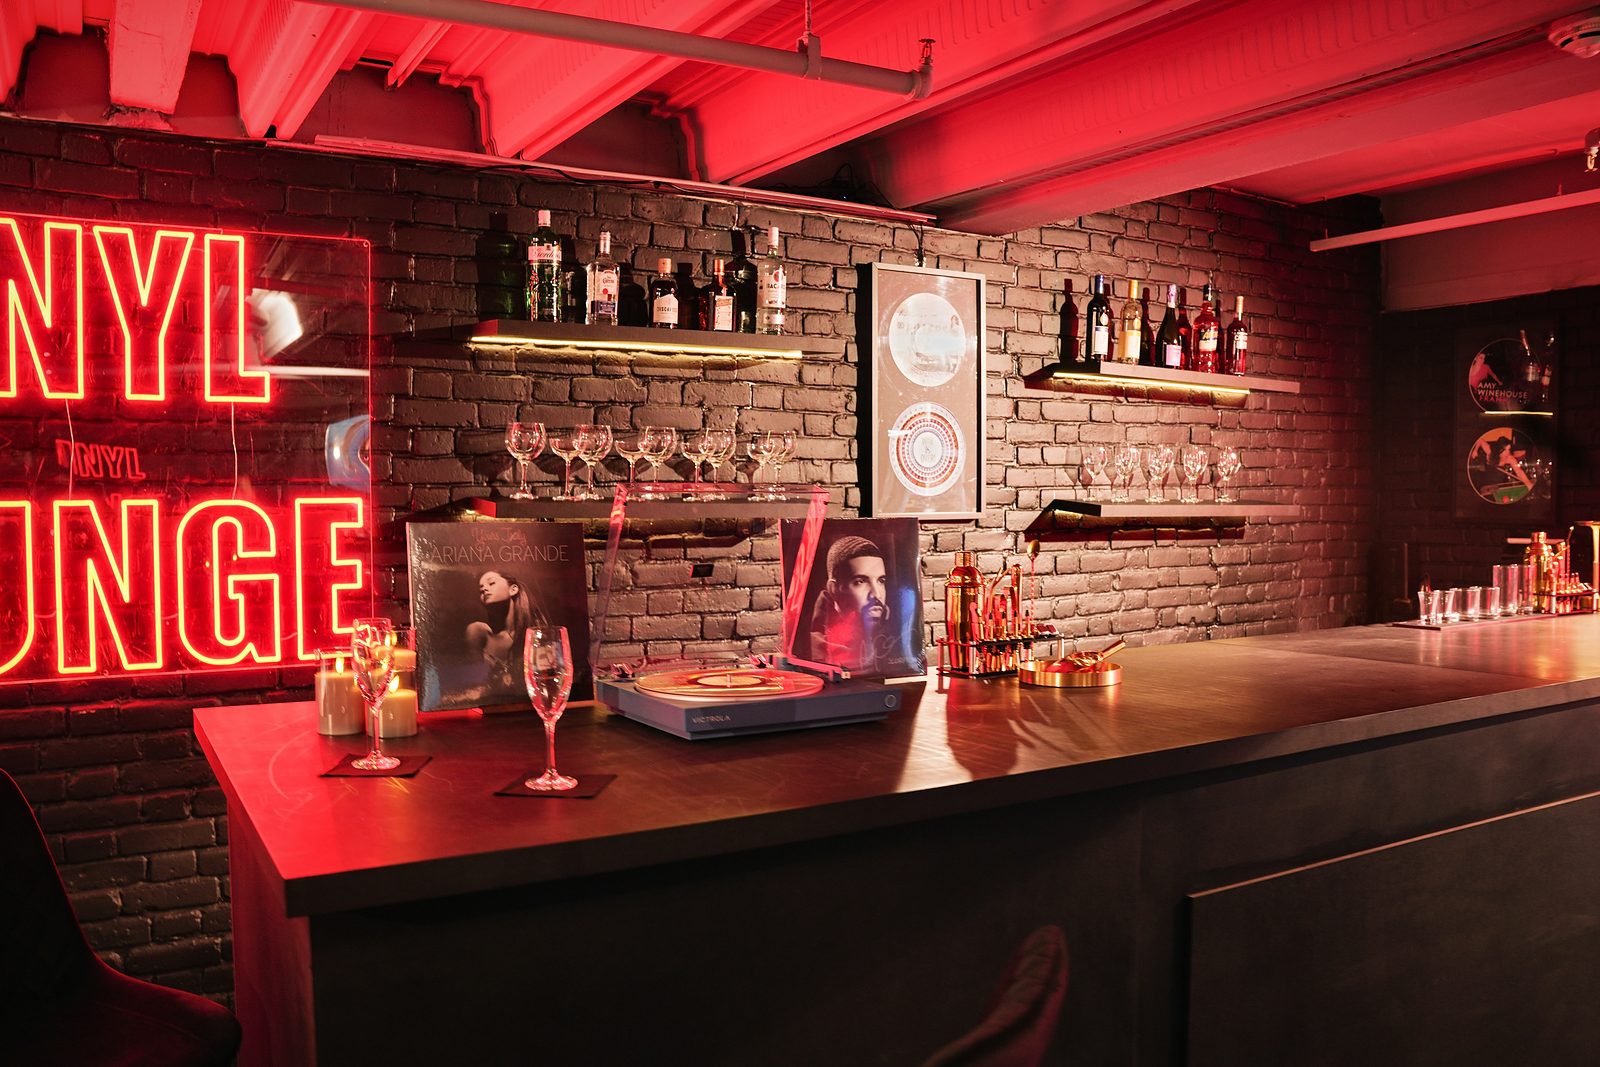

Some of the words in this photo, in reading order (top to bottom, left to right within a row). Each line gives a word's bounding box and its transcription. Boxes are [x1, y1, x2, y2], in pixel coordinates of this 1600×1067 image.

[0, 217, 271, 403] NYL
[1477, 389, 1528, 399] WINEHOUSE
[431, 544, 495, 562] ARIANA
[498, 544, 569, 562] GRANDE
